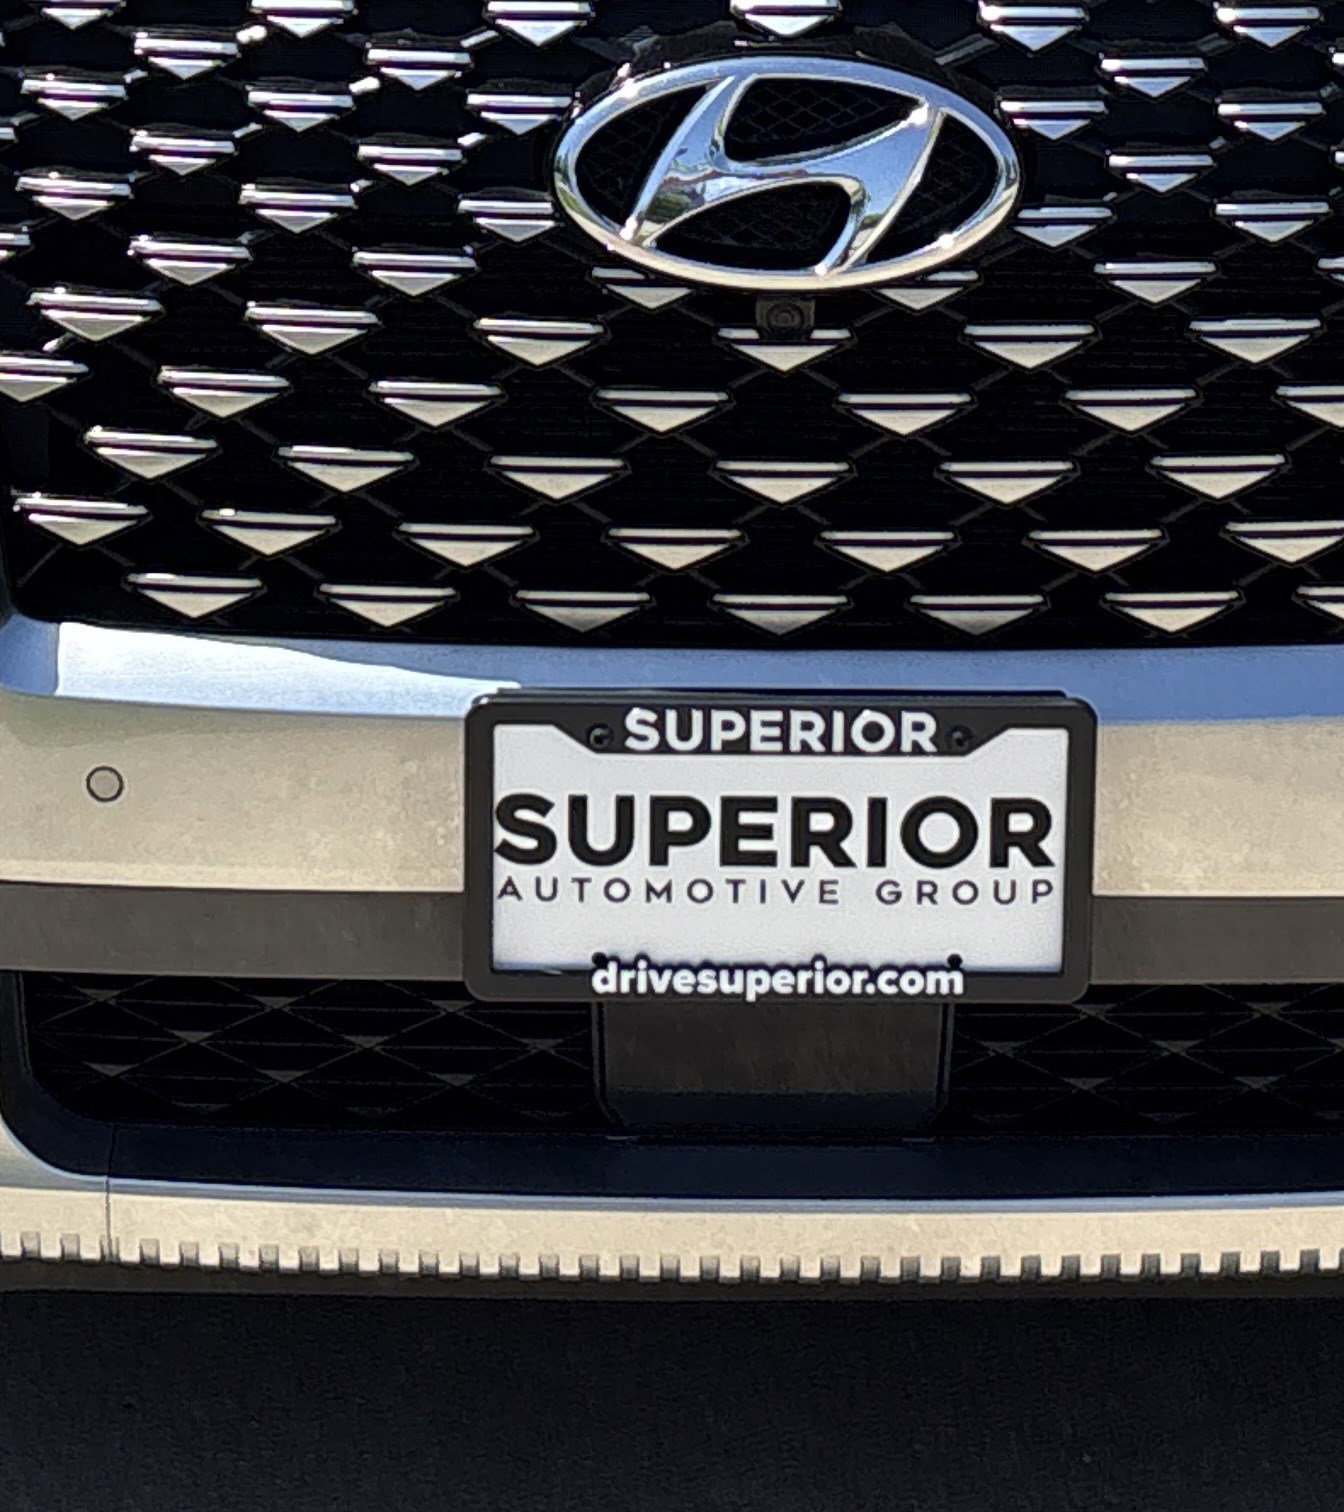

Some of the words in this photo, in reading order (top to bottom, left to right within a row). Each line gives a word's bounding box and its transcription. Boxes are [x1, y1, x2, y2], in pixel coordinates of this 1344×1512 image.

[624, 707, 937, 753] SUPERIOR
[494, 793, 1055, 869] SUPERIOR
[496, 875, 839, 905] AUTOMOTIVE
[875, 879, 1055, 906] GROUP
[591, 960, 964, 1002] drivesuperior.com
